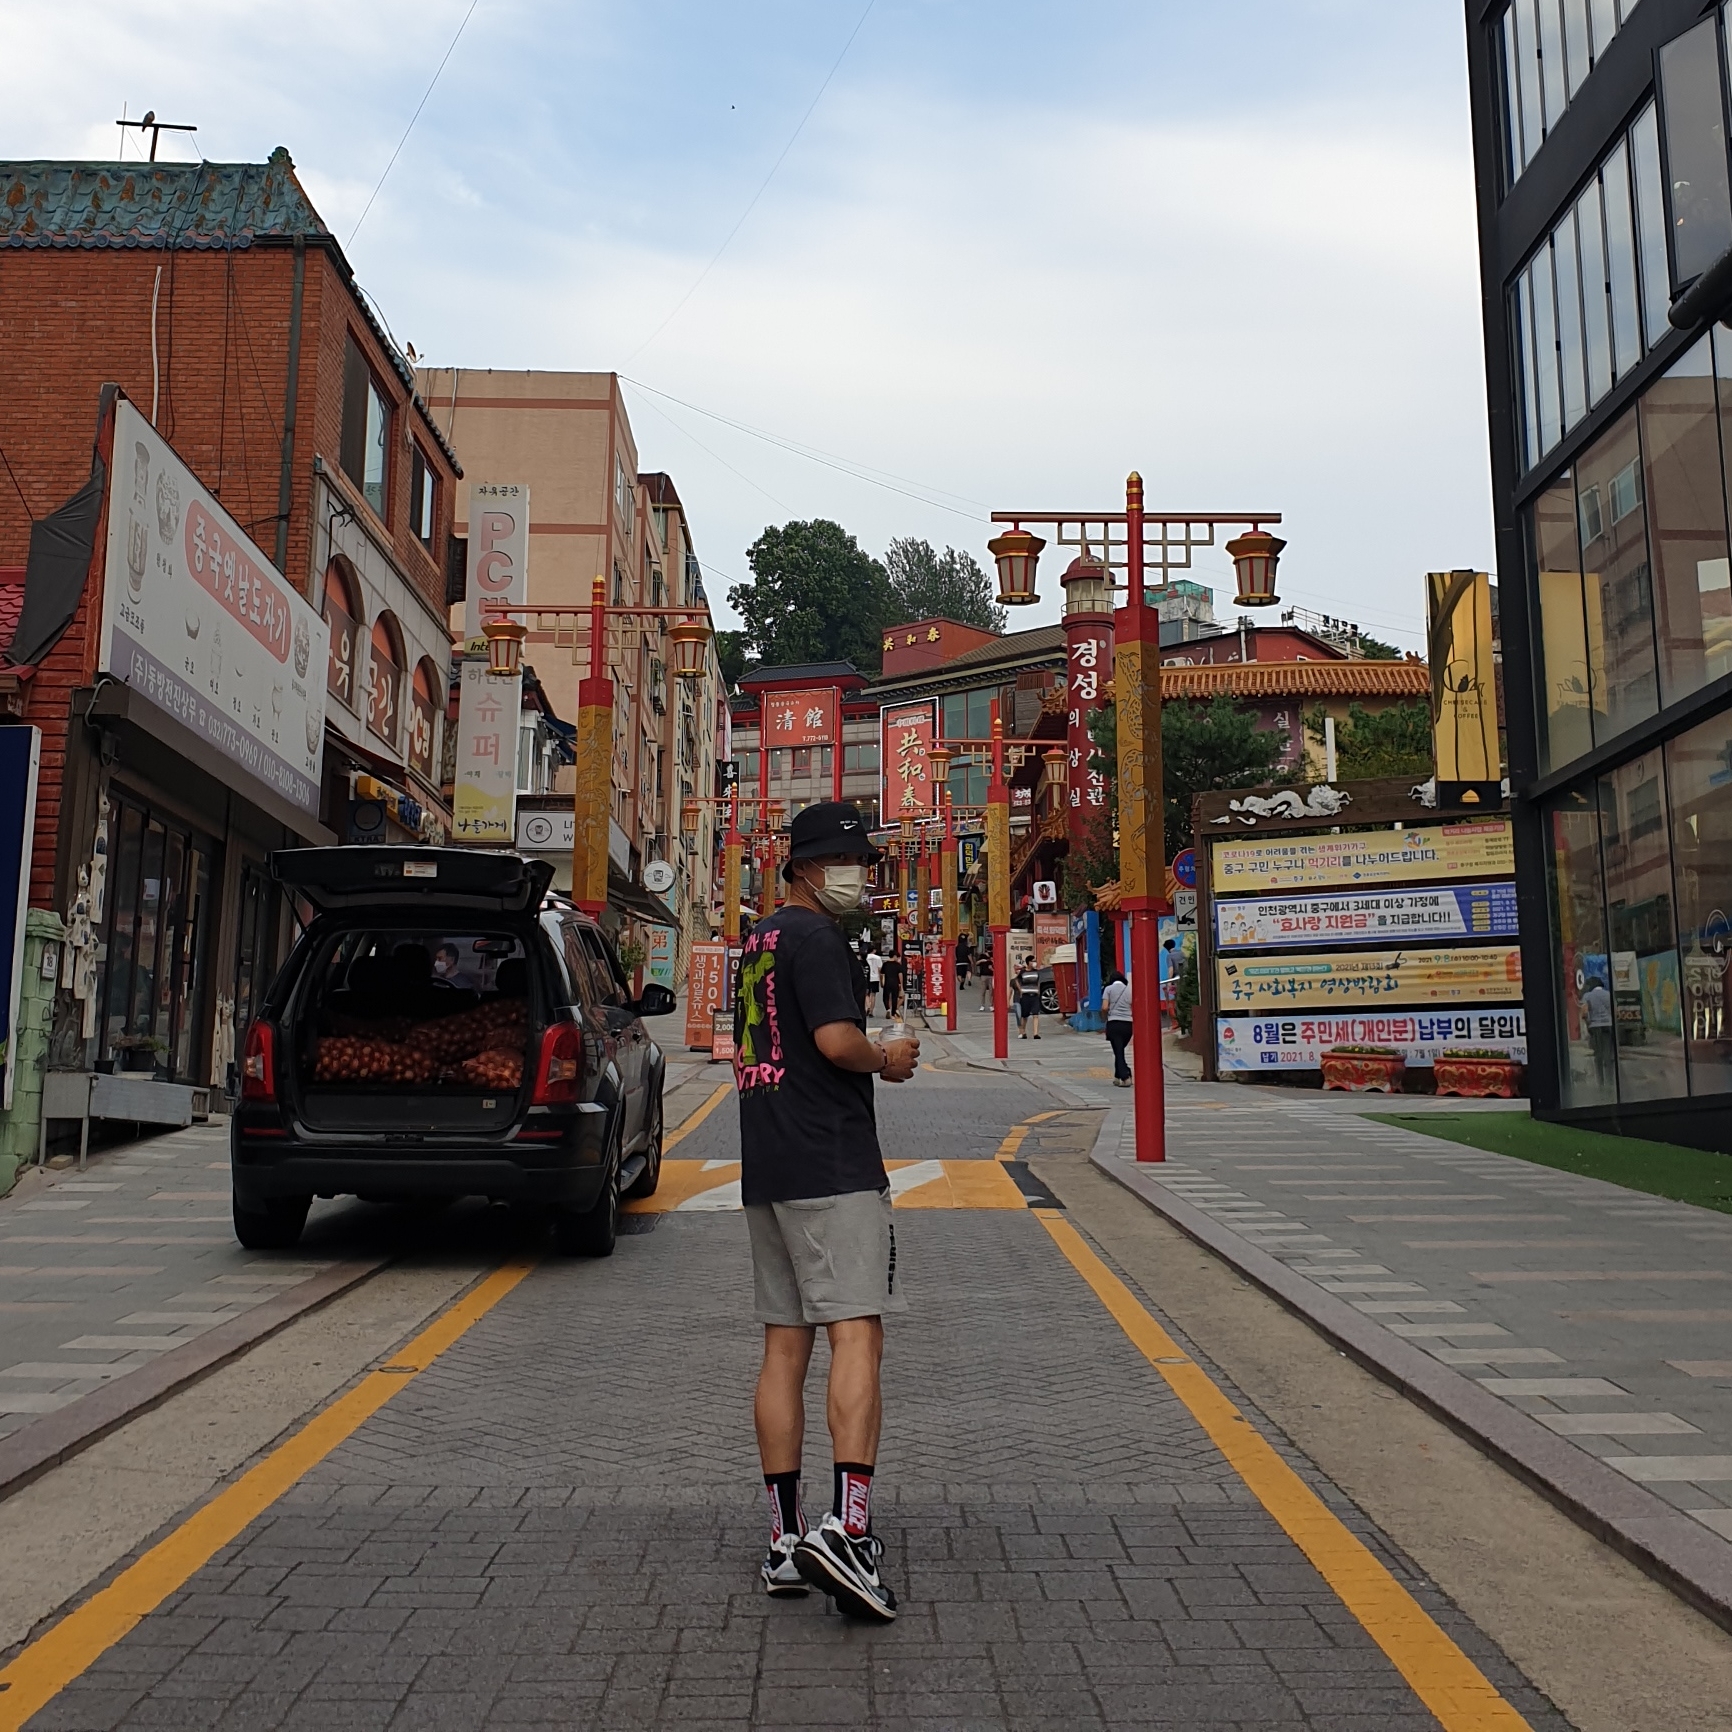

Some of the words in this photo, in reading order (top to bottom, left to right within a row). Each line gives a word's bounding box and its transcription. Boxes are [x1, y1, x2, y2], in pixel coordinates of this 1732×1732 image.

[479, 486, 519, 496] 자유공간
[883, 626, 941, 651] 共和春
[1071, 639, 1098, 700] 경성
[367, 661, 394, 737] 공간
[470, 692, 503, 766] 슈퍼
[775, 706, 824, 731] 清館
[896, 727, 925, 813] 共和春
[457, 818, 508, 835] 나들가게
[1224, 863, 1244, 875] 중구
[1248, 861, 1269, 873] 구민
[1272, 859, 1304, 871] 누구나
[1355, 849, 1439, 865] 나누어드립니다.
[1179, 896, 1195, 905] 견인
[1258, 904, 1307, 916] 인천광역시
[1310, 902, 1349, 914] 중구에서
[1353, 899, 1380, 911] 3세대
[1384, 898, 1404, 909] 이상
[1408, 896, 1440, 908] 가정에
[1390, 912, 1451, 925] 지급합니다!!
[763, 929, 781, 950] THE
[691, 954, 707, 1022] 생과일쥬스
[1232, 979, 1255, 1001] 중구
[1258, 978, 1312, 999] 사회복지
[1319, 973, 1399, 996] 영상박람회
[766, 971, 783, 1061] WINGS
[1253, 1022, 1297, 1045] 8월은
[1262, 1053, 1276, 1062] 납기
[848, 1479, 868, 1533] PALACE
